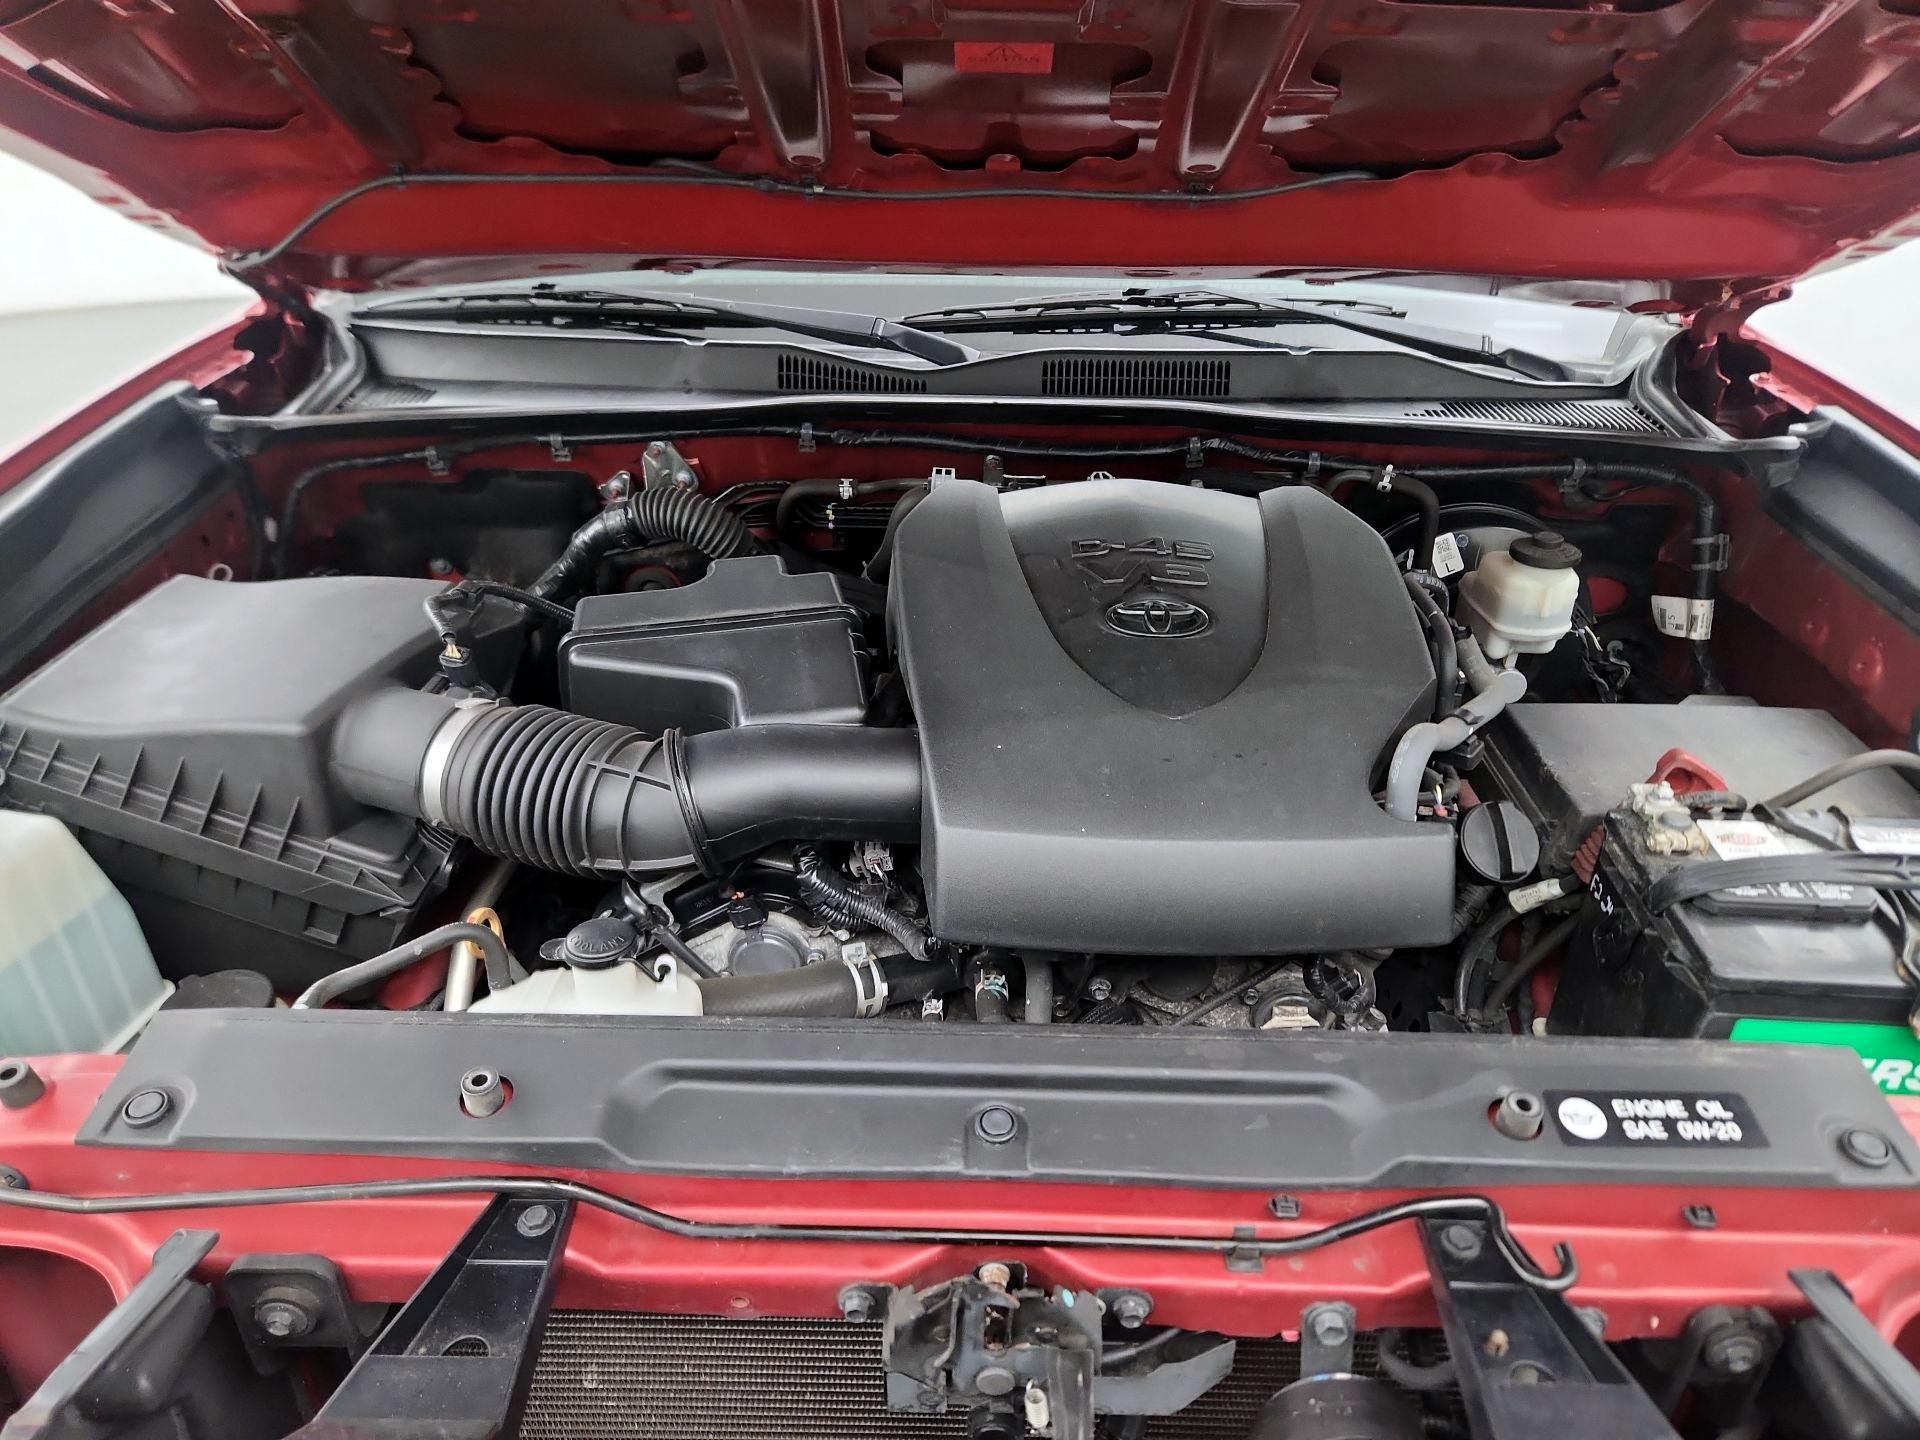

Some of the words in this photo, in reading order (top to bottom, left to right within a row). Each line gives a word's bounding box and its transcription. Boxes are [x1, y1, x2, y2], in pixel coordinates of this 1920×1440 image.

[569, 935, 625, 952] COOLANT
[1611, 1098, 1690, 1119] ENGINE
[1695, 1099, 1734, 1120] OIL
[1622, 1119, 1669, 1140] SAE
